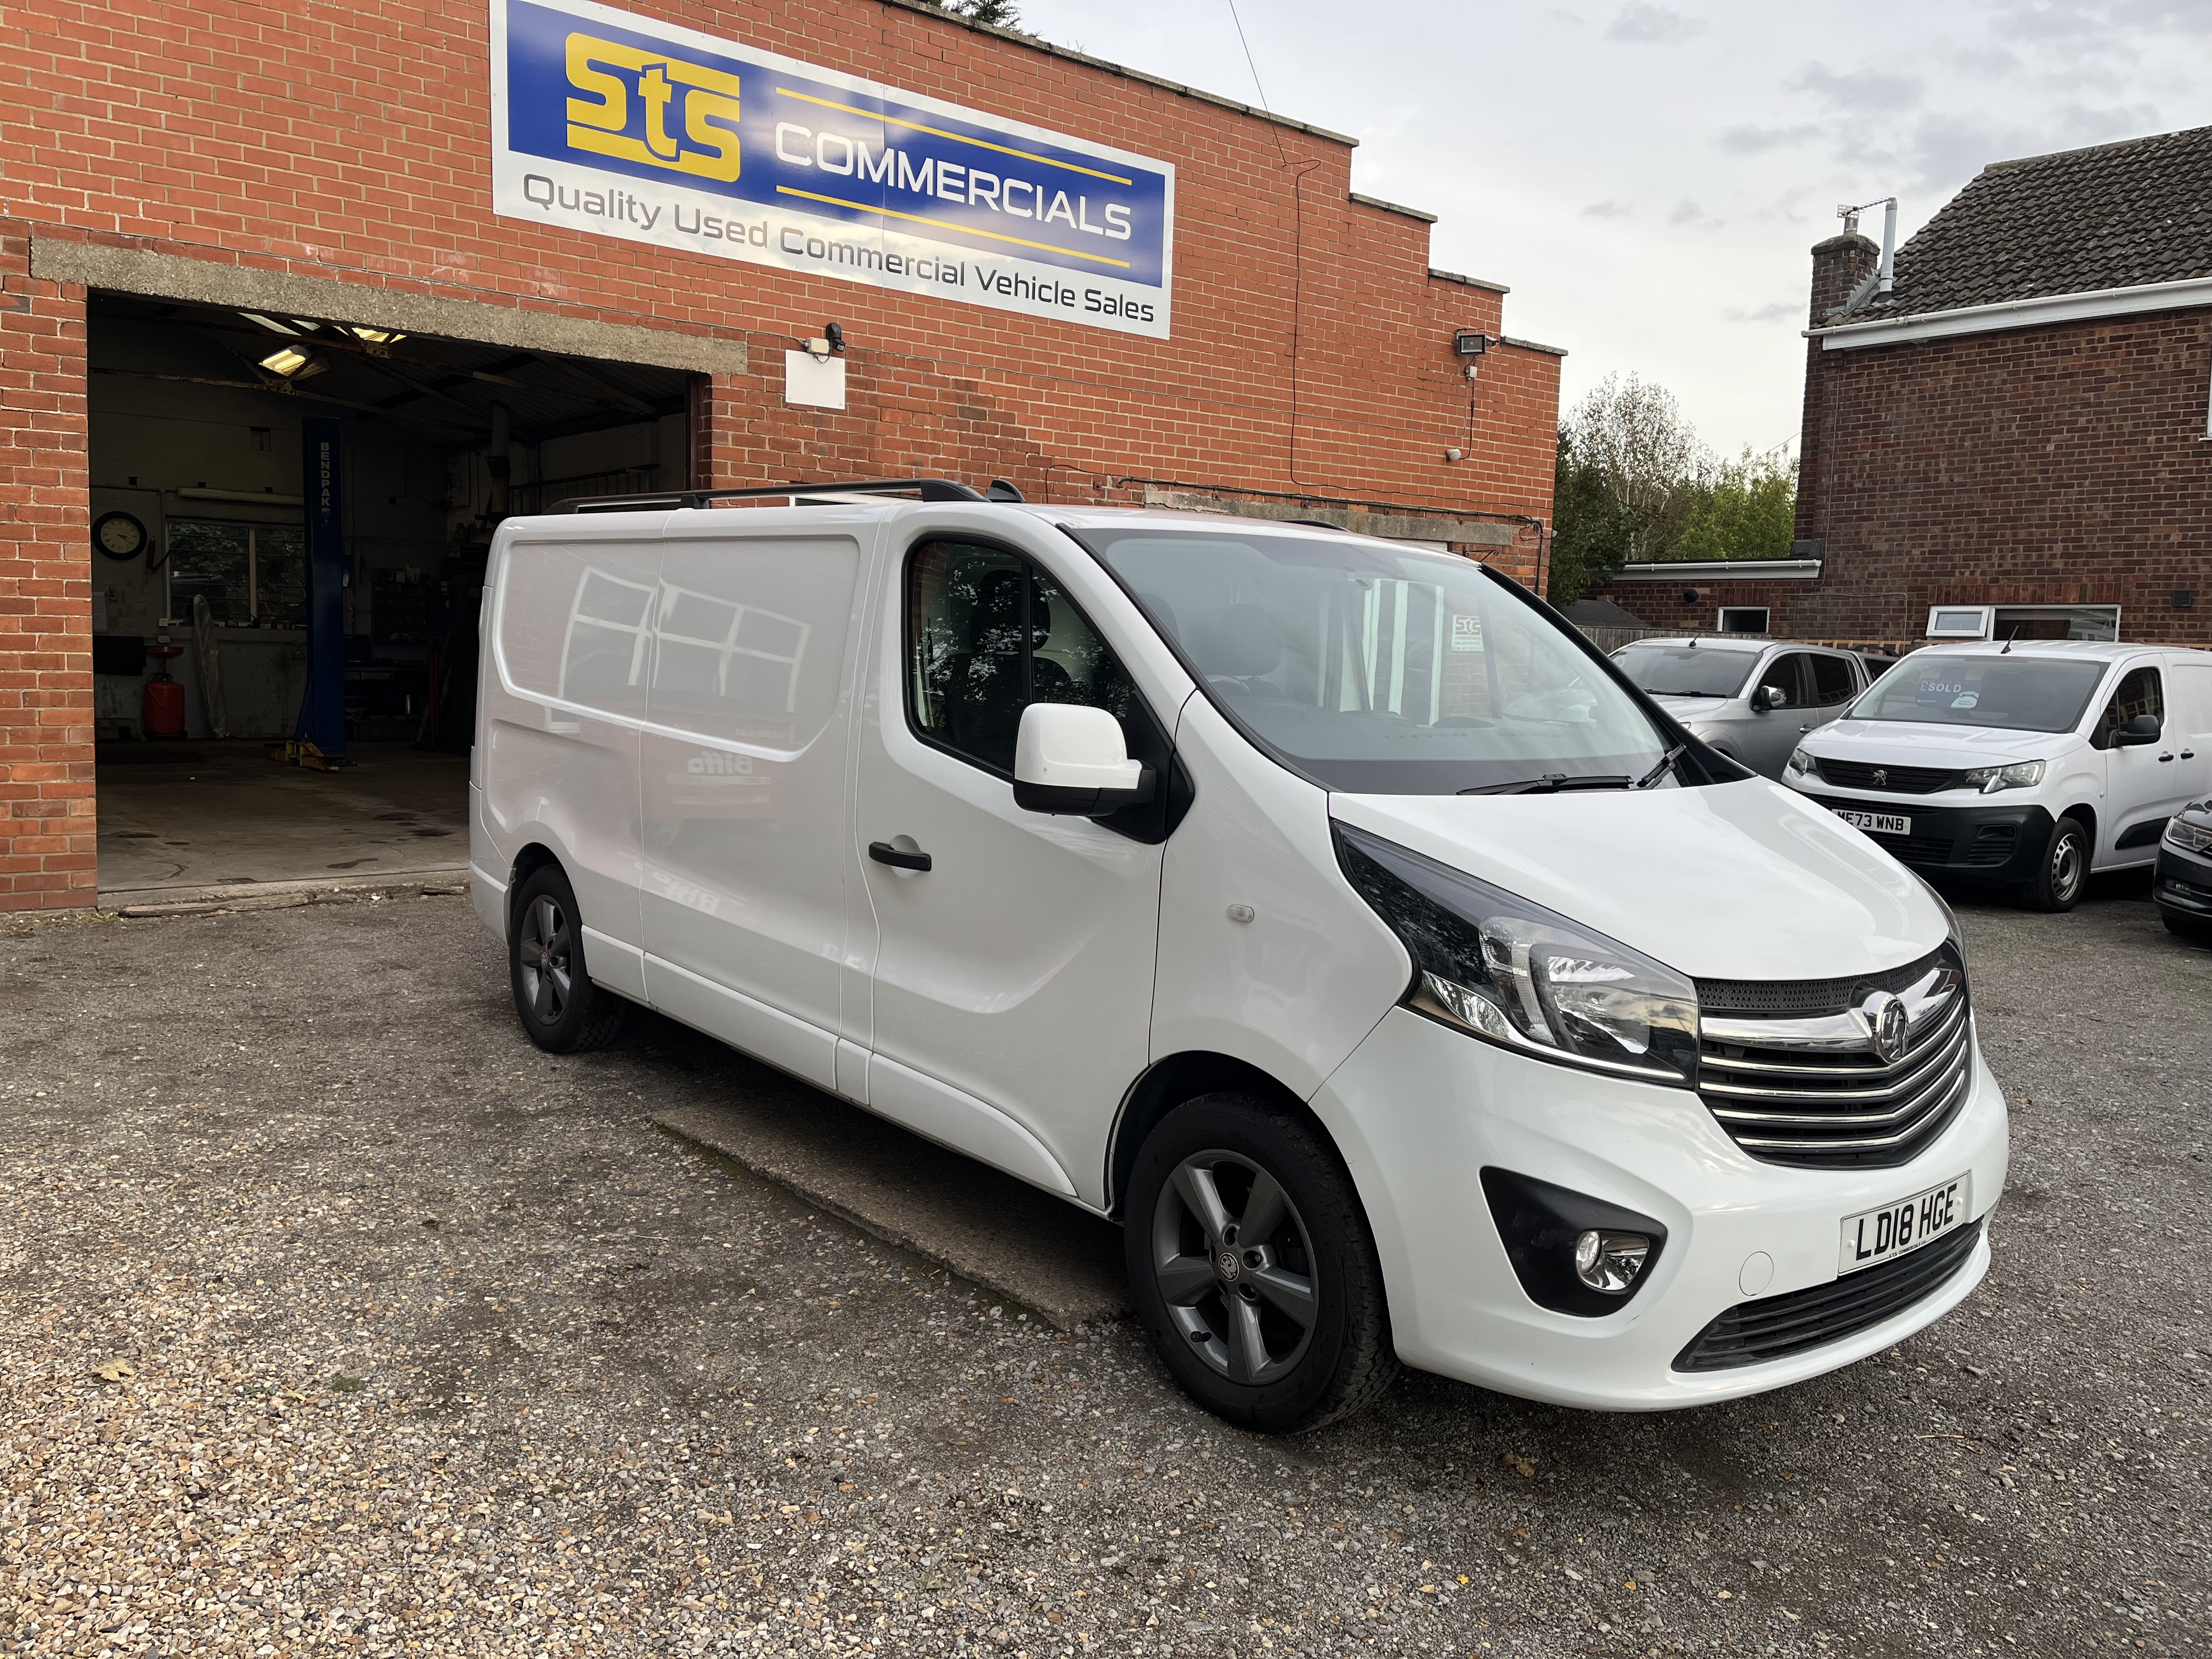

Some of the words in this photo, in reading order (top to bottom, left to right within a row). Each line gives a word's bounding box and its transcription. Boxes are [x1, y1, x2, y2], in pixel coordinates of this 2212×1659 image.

[775, 121, 1132, 240] COMMERCIALS
[523, 173, 662, 230] Quality
[674, 204, 768, 249] Used
[780, 226, 965, 286] Commercial
[974, 265, 1075, 308] Vehicle
[1084, 288, 1154, 323] Sales
[320, 442, 330, 506] BENDPAK
[1876, 815, 1904, 831] WNB
[1855, 1203, 1915, 1261] LD18
[1918, 1182, 1958, 1239] HGE
